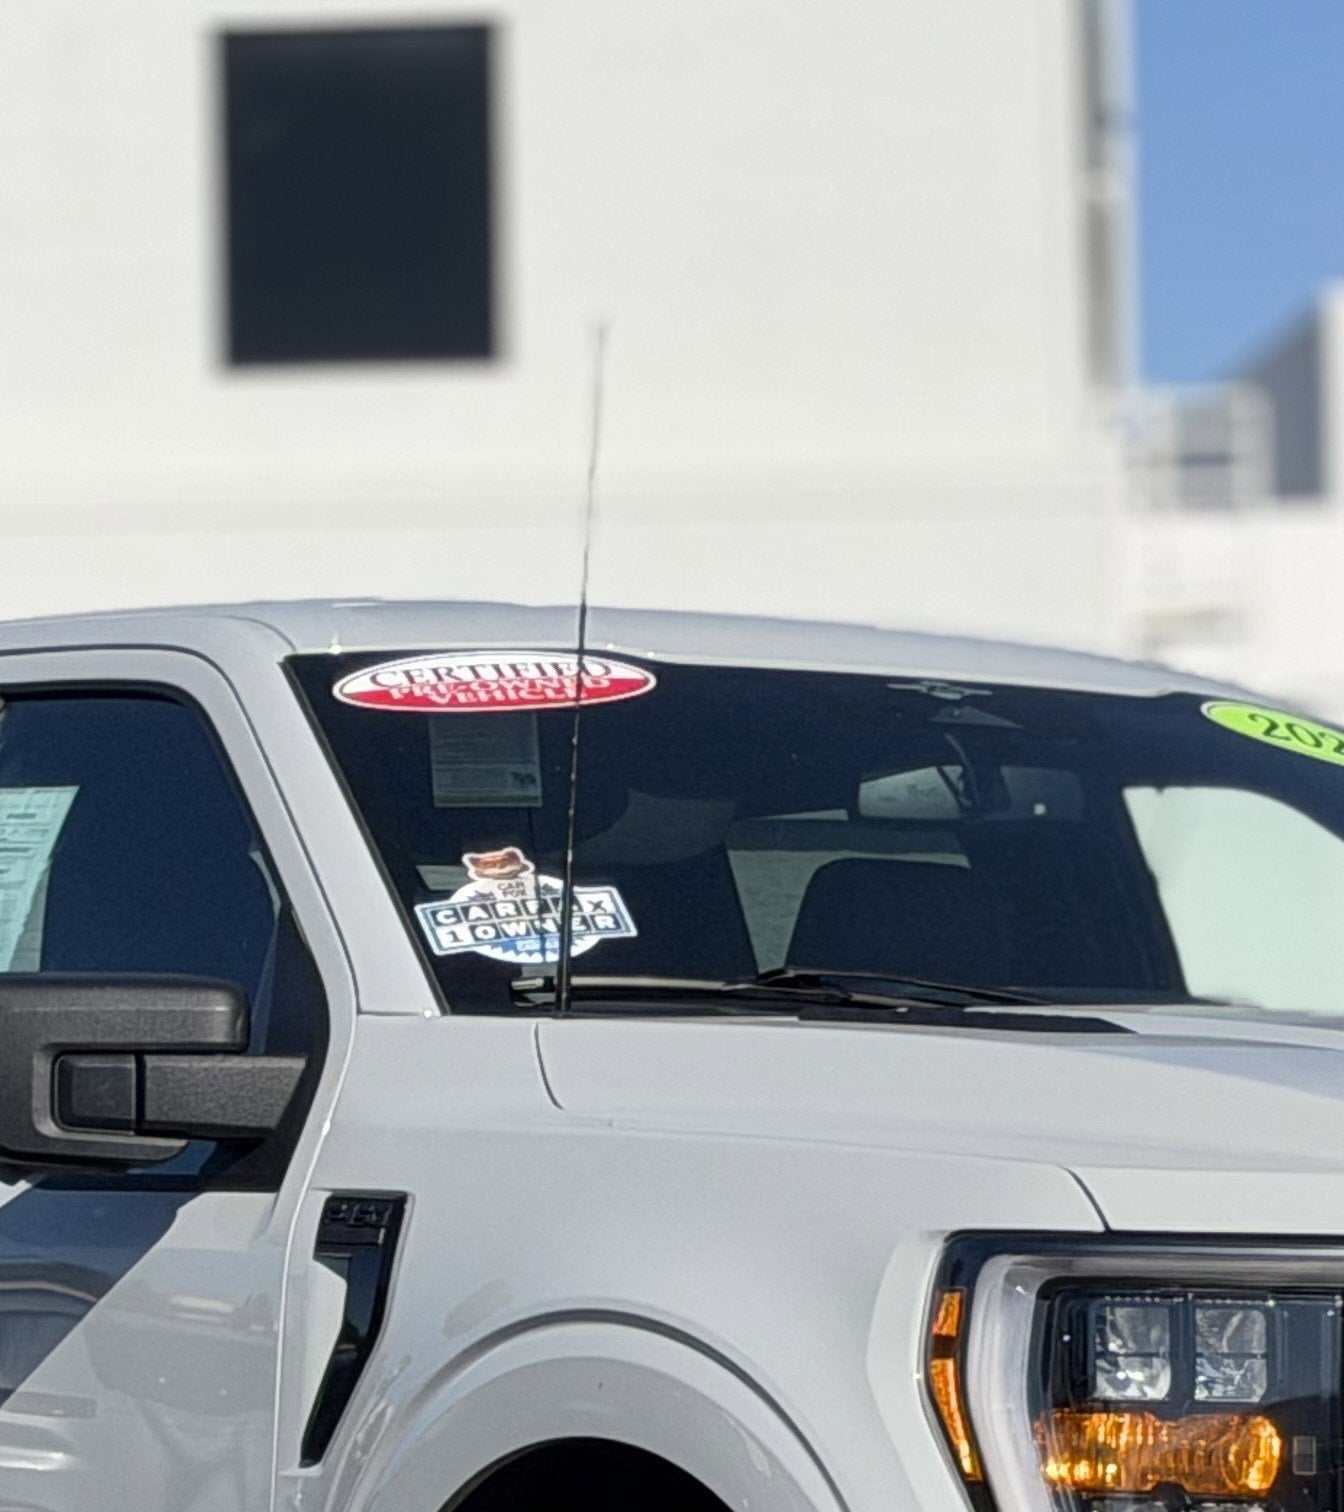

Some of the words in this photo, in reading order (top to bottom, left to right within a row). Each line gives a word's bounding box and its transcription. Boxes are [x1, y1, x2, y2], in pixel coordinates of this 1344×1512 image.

[369, 660, 612, 688] CERTIFIED
[387, 677, 612, 700] PRE-OWNED
[428, 686, 587, 705] VEHICLE
